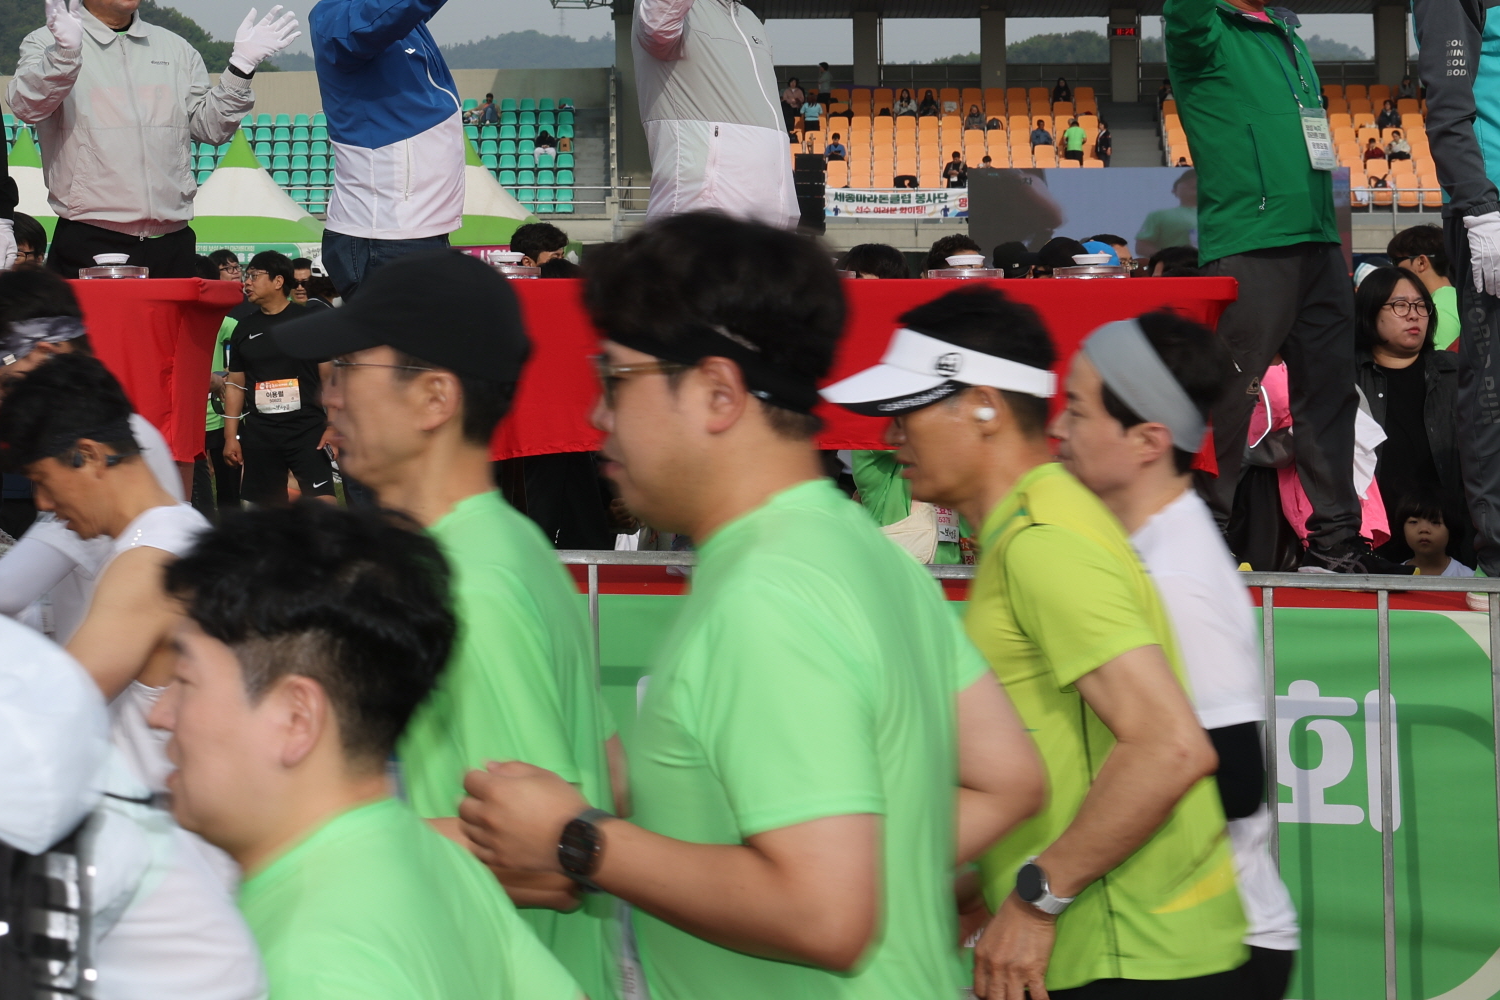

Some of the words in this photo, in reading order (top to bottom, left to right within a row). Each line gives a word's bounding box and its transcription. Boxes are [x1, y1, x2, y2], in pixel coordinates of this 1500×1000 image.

[833, 191, 911, 204] 세종마라톤클럽
[915, 191, 949, 204] 봉사단
[855, 205, 871, 214] 선수
[873, 205, 897, 214] 여러분
[899, 205, 927, 215] 화이팅!
[1260, 679, 1402, 833] 회
